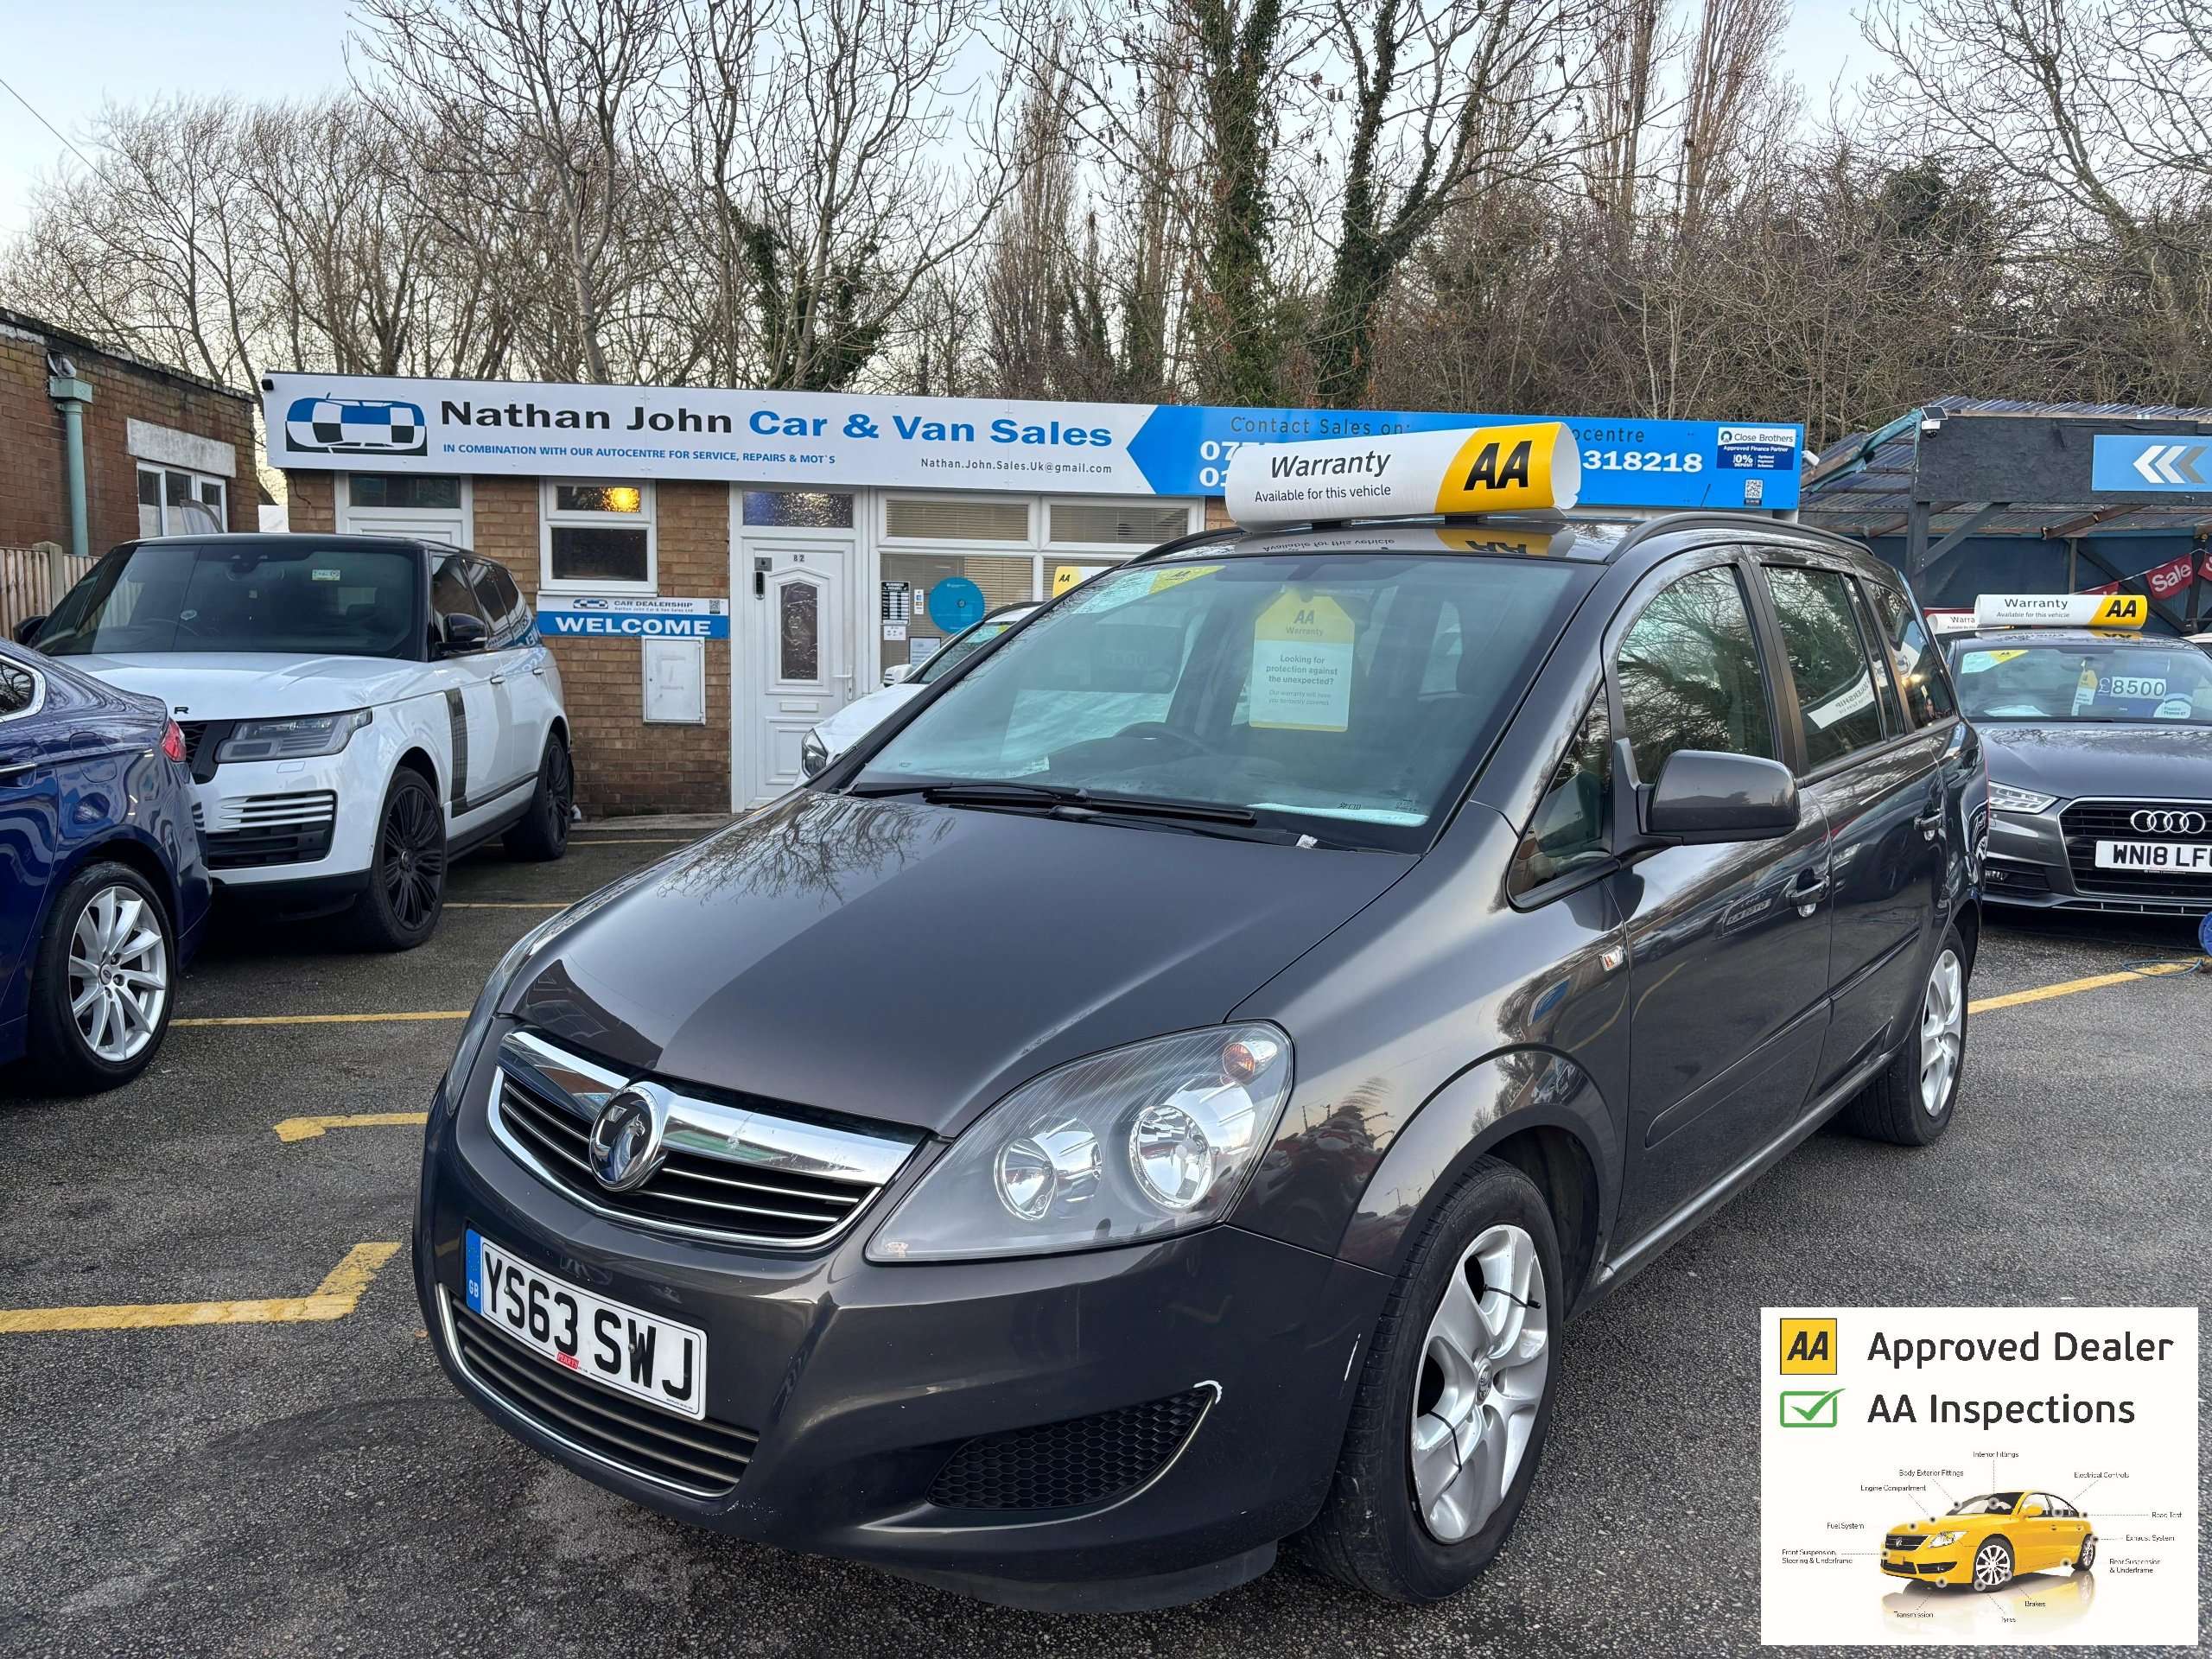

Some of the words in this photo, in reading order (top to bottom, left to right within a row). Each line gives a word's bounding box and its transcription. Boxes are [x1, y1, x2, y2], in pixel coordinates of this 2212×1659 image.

[441, 400, 610, 430] Nathan
[626, 406, 732, 433] John
[749, 410, 828, 436] Car
[842, 413, 880, 439] &
[892, 415, 975, 442] Van
[989, 418, 1113, 447] Sales
[1230, 416, 1309, 434] Contact
[1319, 418, 1371, 435] Sales
[1572, 427, 1645, 443] ocentre
[1734, 433, 1757, 442] Close
[1759, 434, 1794, 442] Brothers
[443, 443, 455, 453] IN
[458, 443, 537, 454] COMBINATION
[539, 446, 567, 455] WITH
[570, 448, 593, 456] OUR
[596, 448, 665, 458] AUTOCENTRE
[669, 449, 690, 459] FOR
[692, 450, 740, 461] SERVICE,
[743, 453, 786, 462] REPAIRS
[789, 454, 798, 462] &
[1582, 449, 1702, 473] 318218
[921, 458, 1113, 474] Nathan.John.Sales.Uk@gmail.com
[1271, 450, 1391, 479] Warranty
[1463, 440, 1533, 491] AA
[1255, 487, 1305, 503] Available
[1307, 486, 1323, 500] for
[1325, 486, 1346, 499] this
[1349, 484, 1392, 498] vehicle
[1058, 574, 1071, 582] AA
[2151, 563, 2192, 592] Sale
[2004, 598, 2068, 610] Warranty
[2106, 600, 2137, 617] AA
[555, 616, 711, 635] WELCOME
[1294, 610, 1315, 624] AA
[1286, 626, 1324, 637] Warranty
[1280, 654, 1312, 664] Looking
[1283, 677, 1334, 685] unexpected?
[1308, 667, 1338, 677] against
[2113, 844, 2168, 866] WN18
[2176, 847, 2212, 868] LF
[468, 1280, 479, 1299] GB
[485, 1252, 578, 1357] YS63
[594, 1308, 692, 1402] SWJ
[556, 1353, 580, 1370] PERRYS
